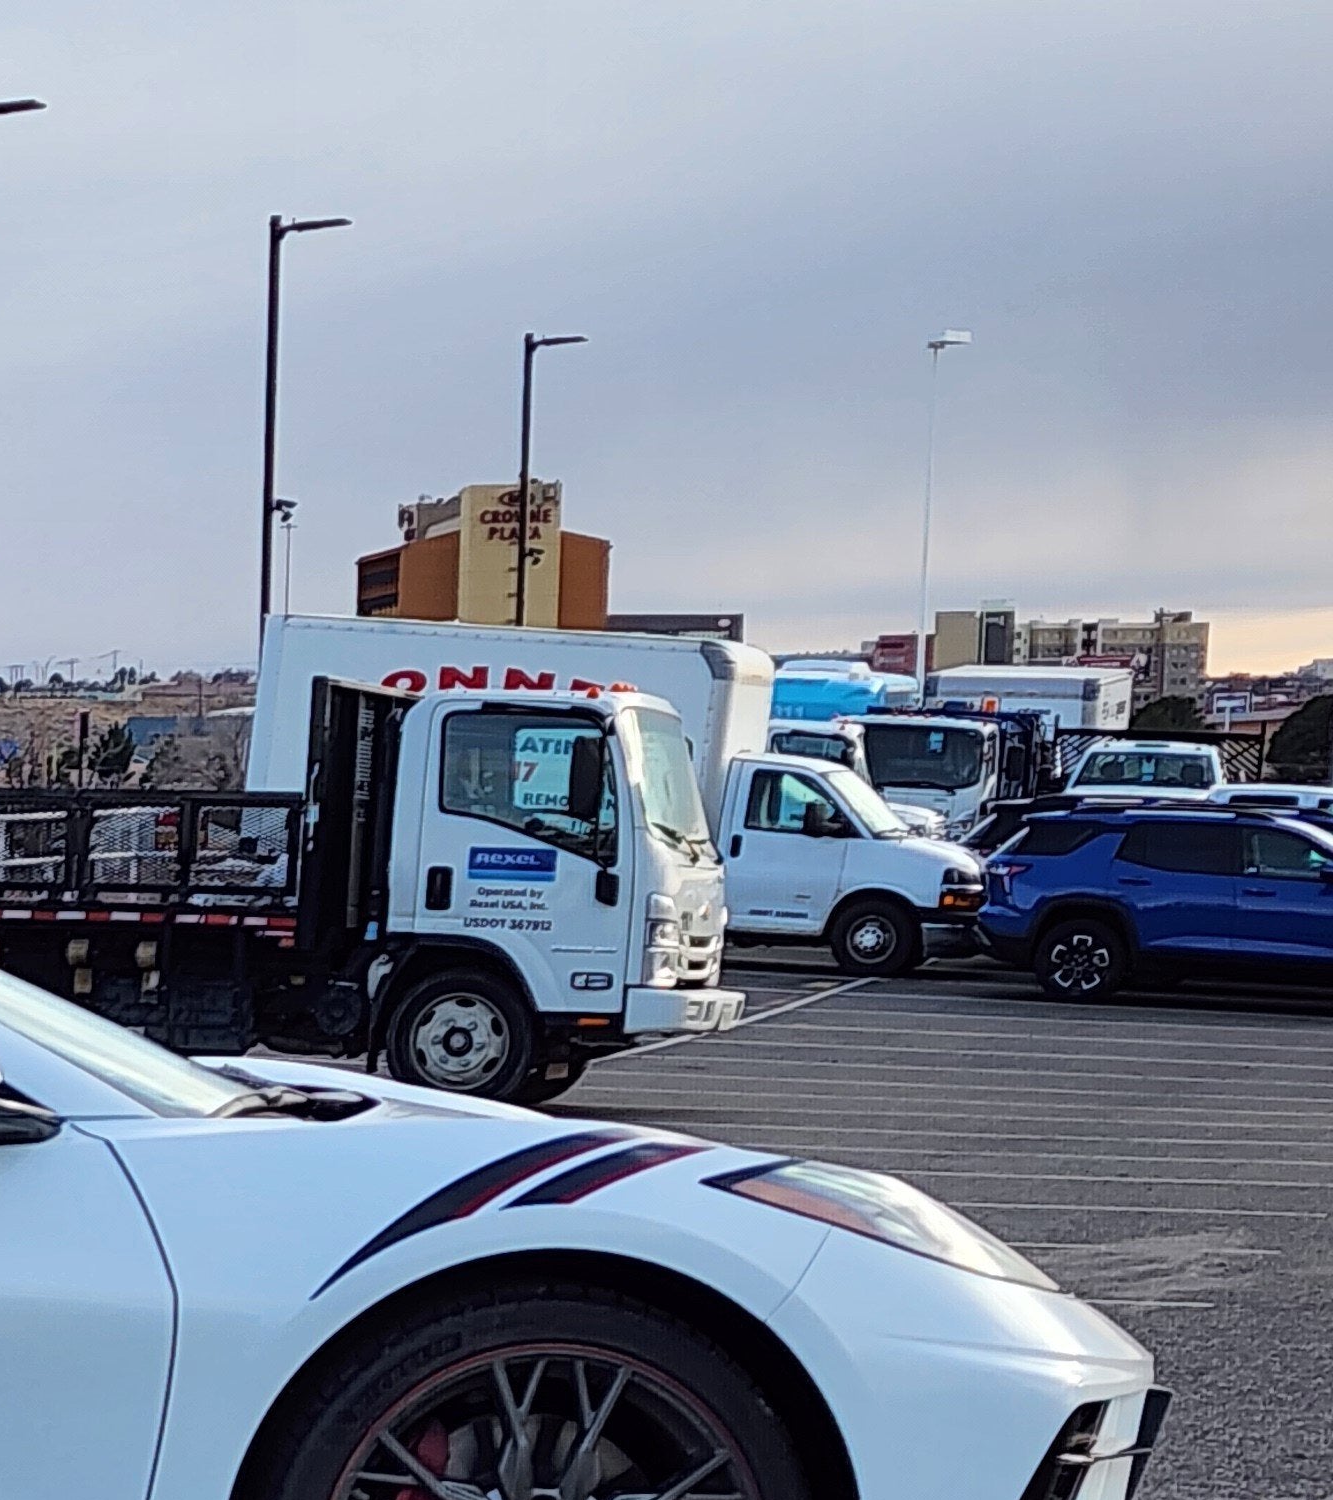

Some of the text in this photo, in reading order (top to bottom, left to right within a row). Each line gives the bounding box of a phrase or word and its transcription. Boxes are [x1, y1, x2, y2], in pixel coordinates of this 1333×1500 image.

[487, 526, 541, 540] PLAA
[477, 886, 544, 899] Operated by
[464, 917, 506, 928] USDOT
